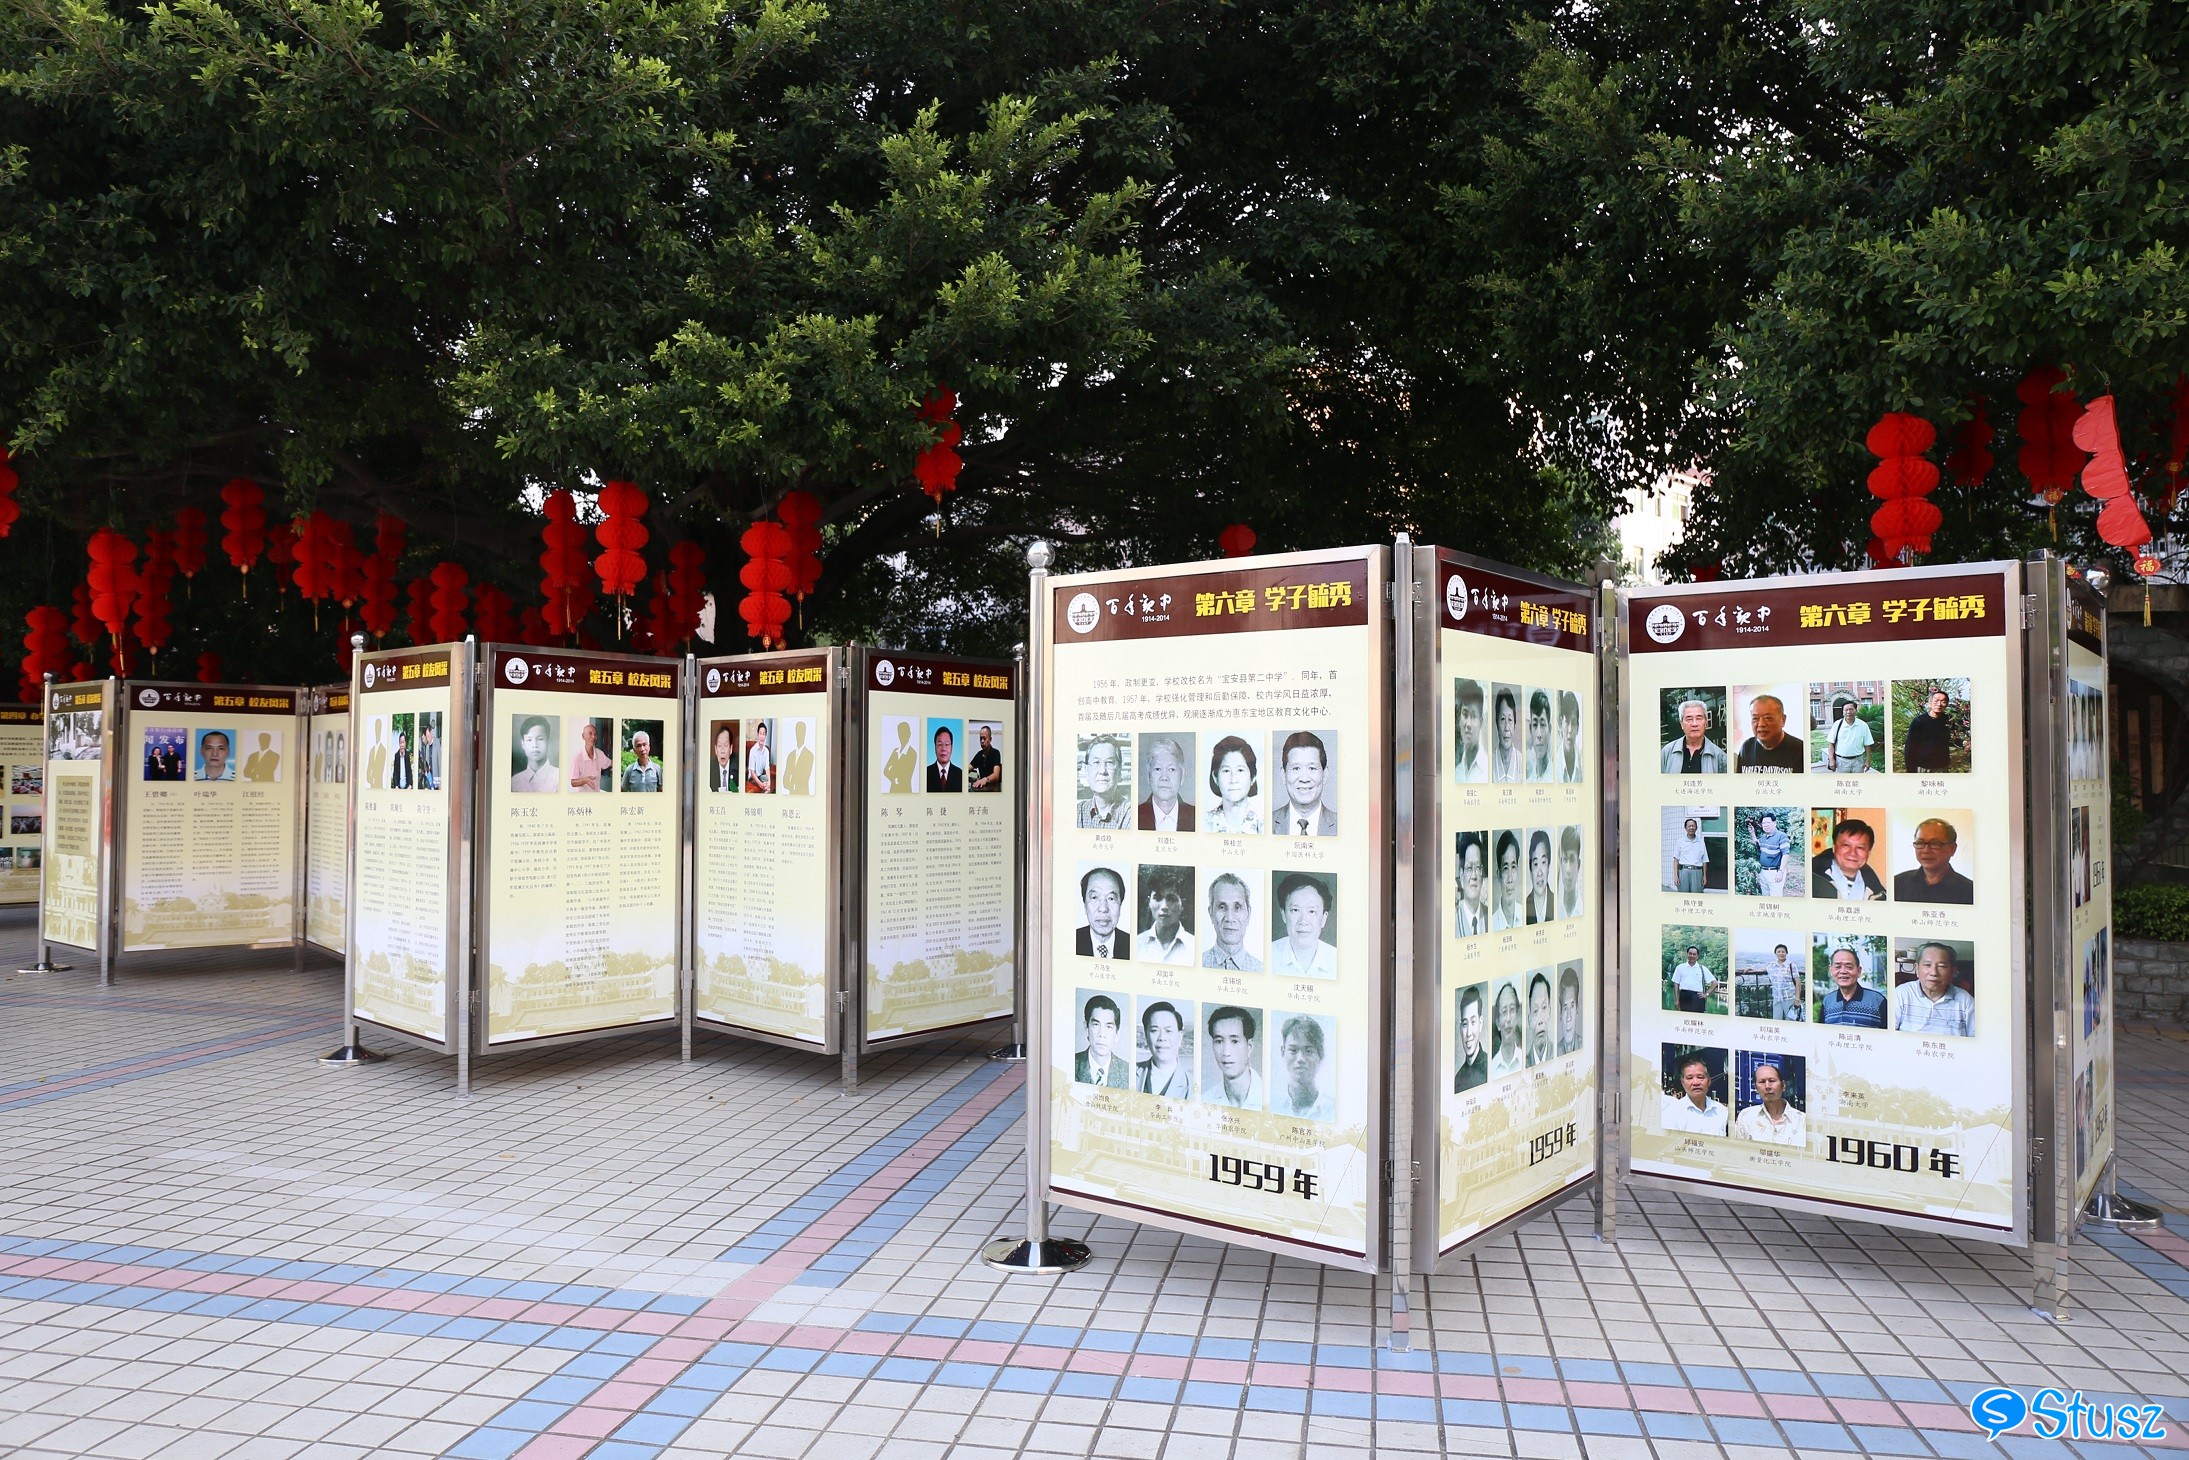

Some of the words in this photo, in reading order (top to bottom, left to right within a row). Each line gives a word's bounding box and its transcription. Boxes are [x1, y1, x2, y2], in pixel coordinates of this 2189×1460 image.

[2139, 560, 2155, 573] 福
[1195, 590, 1256, 617] 第六章
[1264, 581, 1352, 611] 学子毓秀
[1142, 614, 1171, 623] 1914-2014
[1520, 600, 1549, 628] 第六章
[1552, 608, 1587, 636] 学子毓秀
[1799, 602, 1872, 629] 第六章
[1882, 594, 1986, 623] 学子毓秀
[1736, 625, 1770, 634] 1914-2014
[402, 665, 421, 680] 第五章
[423, 661, 448, 678] 校友风采
[590, 669, 624, 685] 第五章
[628, 672, 672, 689] 校友风采
[760, 671, 784, 685] 第五章
[787, 667, 822, 684] 校友风采
[943, 671, 971, 687] 第五章
[974, 675, 1009, 690] 校友风采
[213, 695, 245, 707] 第五章
